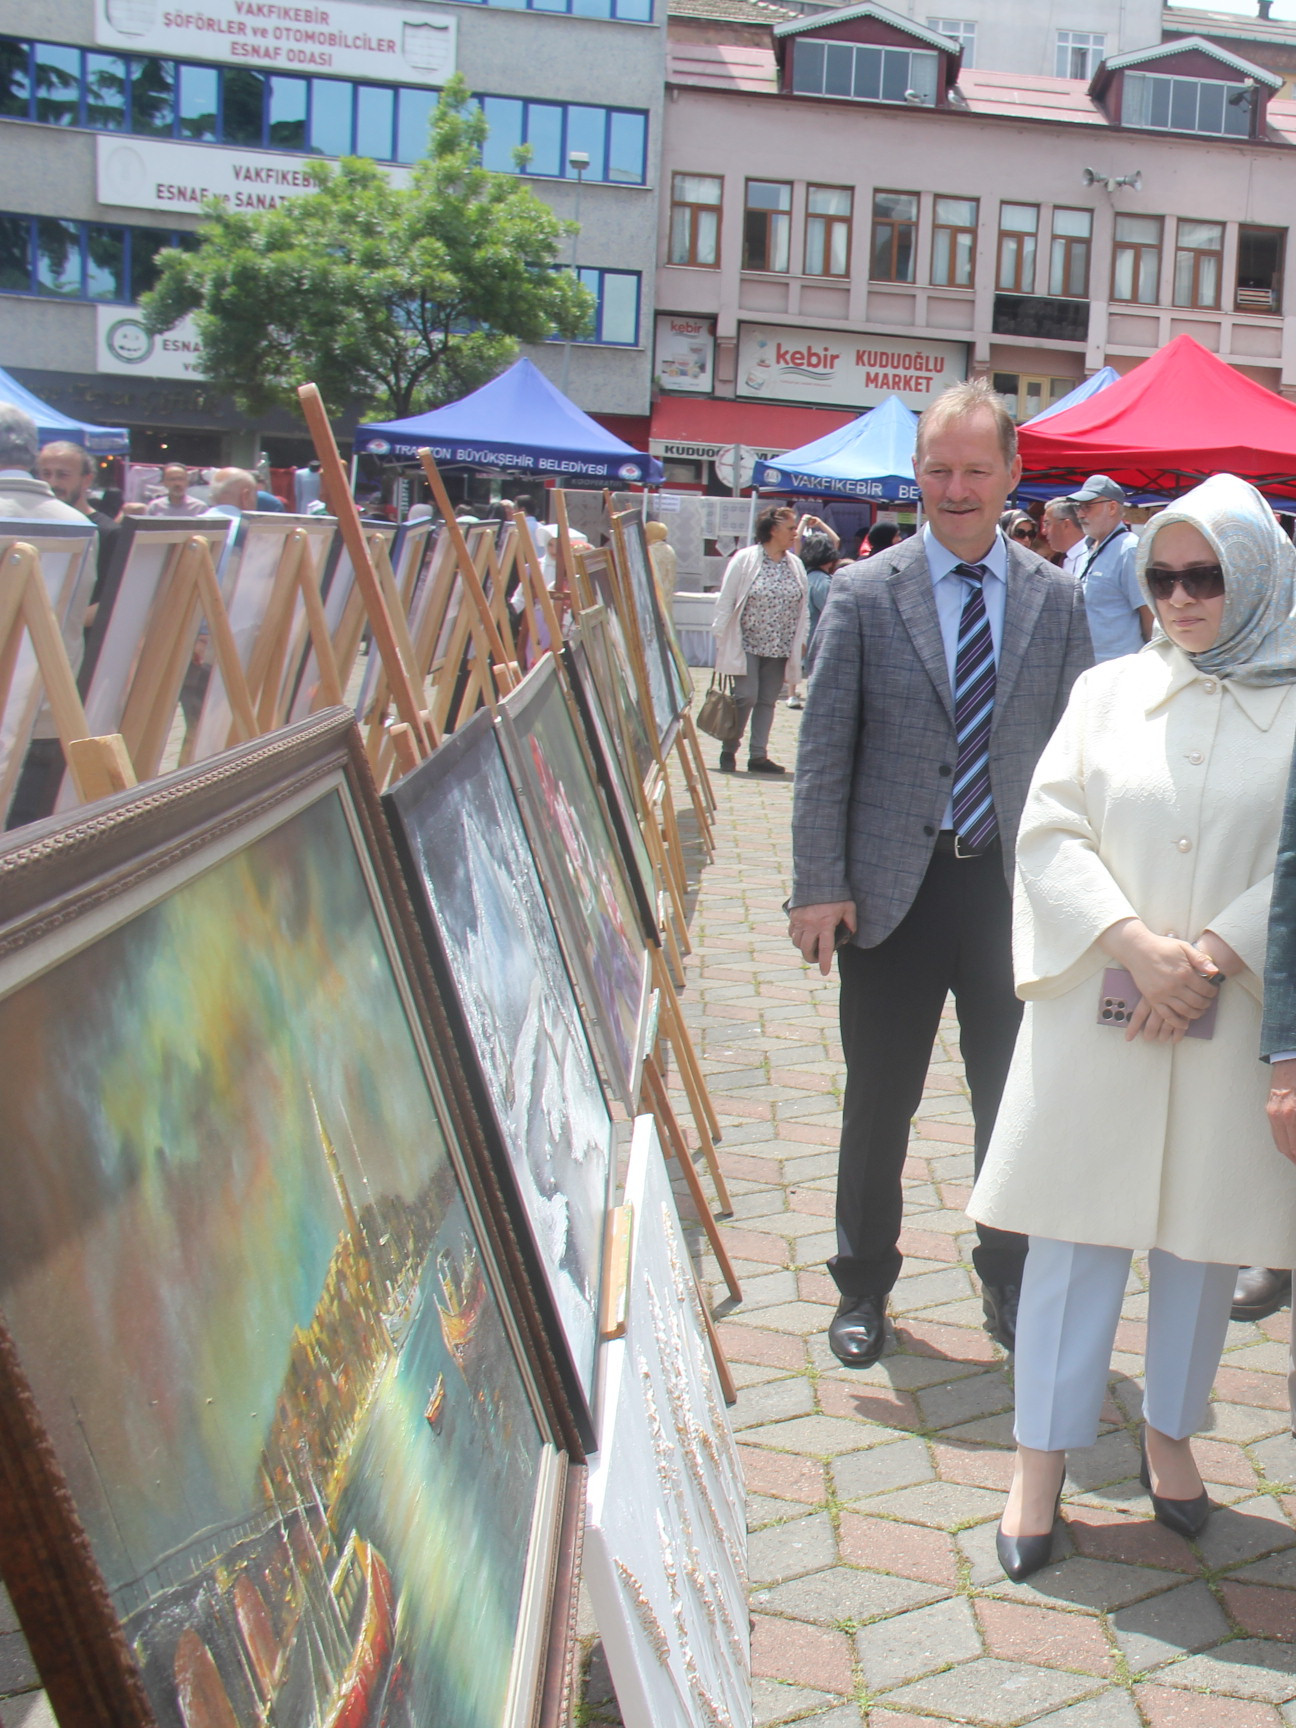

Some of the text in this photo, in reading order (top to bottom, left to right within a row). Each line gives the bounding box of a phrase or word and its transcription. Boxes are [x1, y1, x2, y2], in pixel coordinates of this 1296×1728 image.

[234, 0, 330, 25] VAKFIKEBİR
[163, 11, 397, 54] ŞÖFÖRLER ve OTOMOBİLCİLER
[231, 42, 333, 67] ESNAF ODASI
[232, 164, 318, 188] VAKFIKEB
[156, 183, 208, 204] ESNAF
[671, 320, 704, 333] kebir
[162, 339, 201, 352] ESNA
[776, 342, 945, 374] kebir KUDUOĞLU
[865, 371, 934, 393] MARKET
[394, 445, 608, 476] TRAON BÜYÜKŞEHİR BELEDİYESİ
[790, 473, 920, 499] VAKFIKEBİR BE
